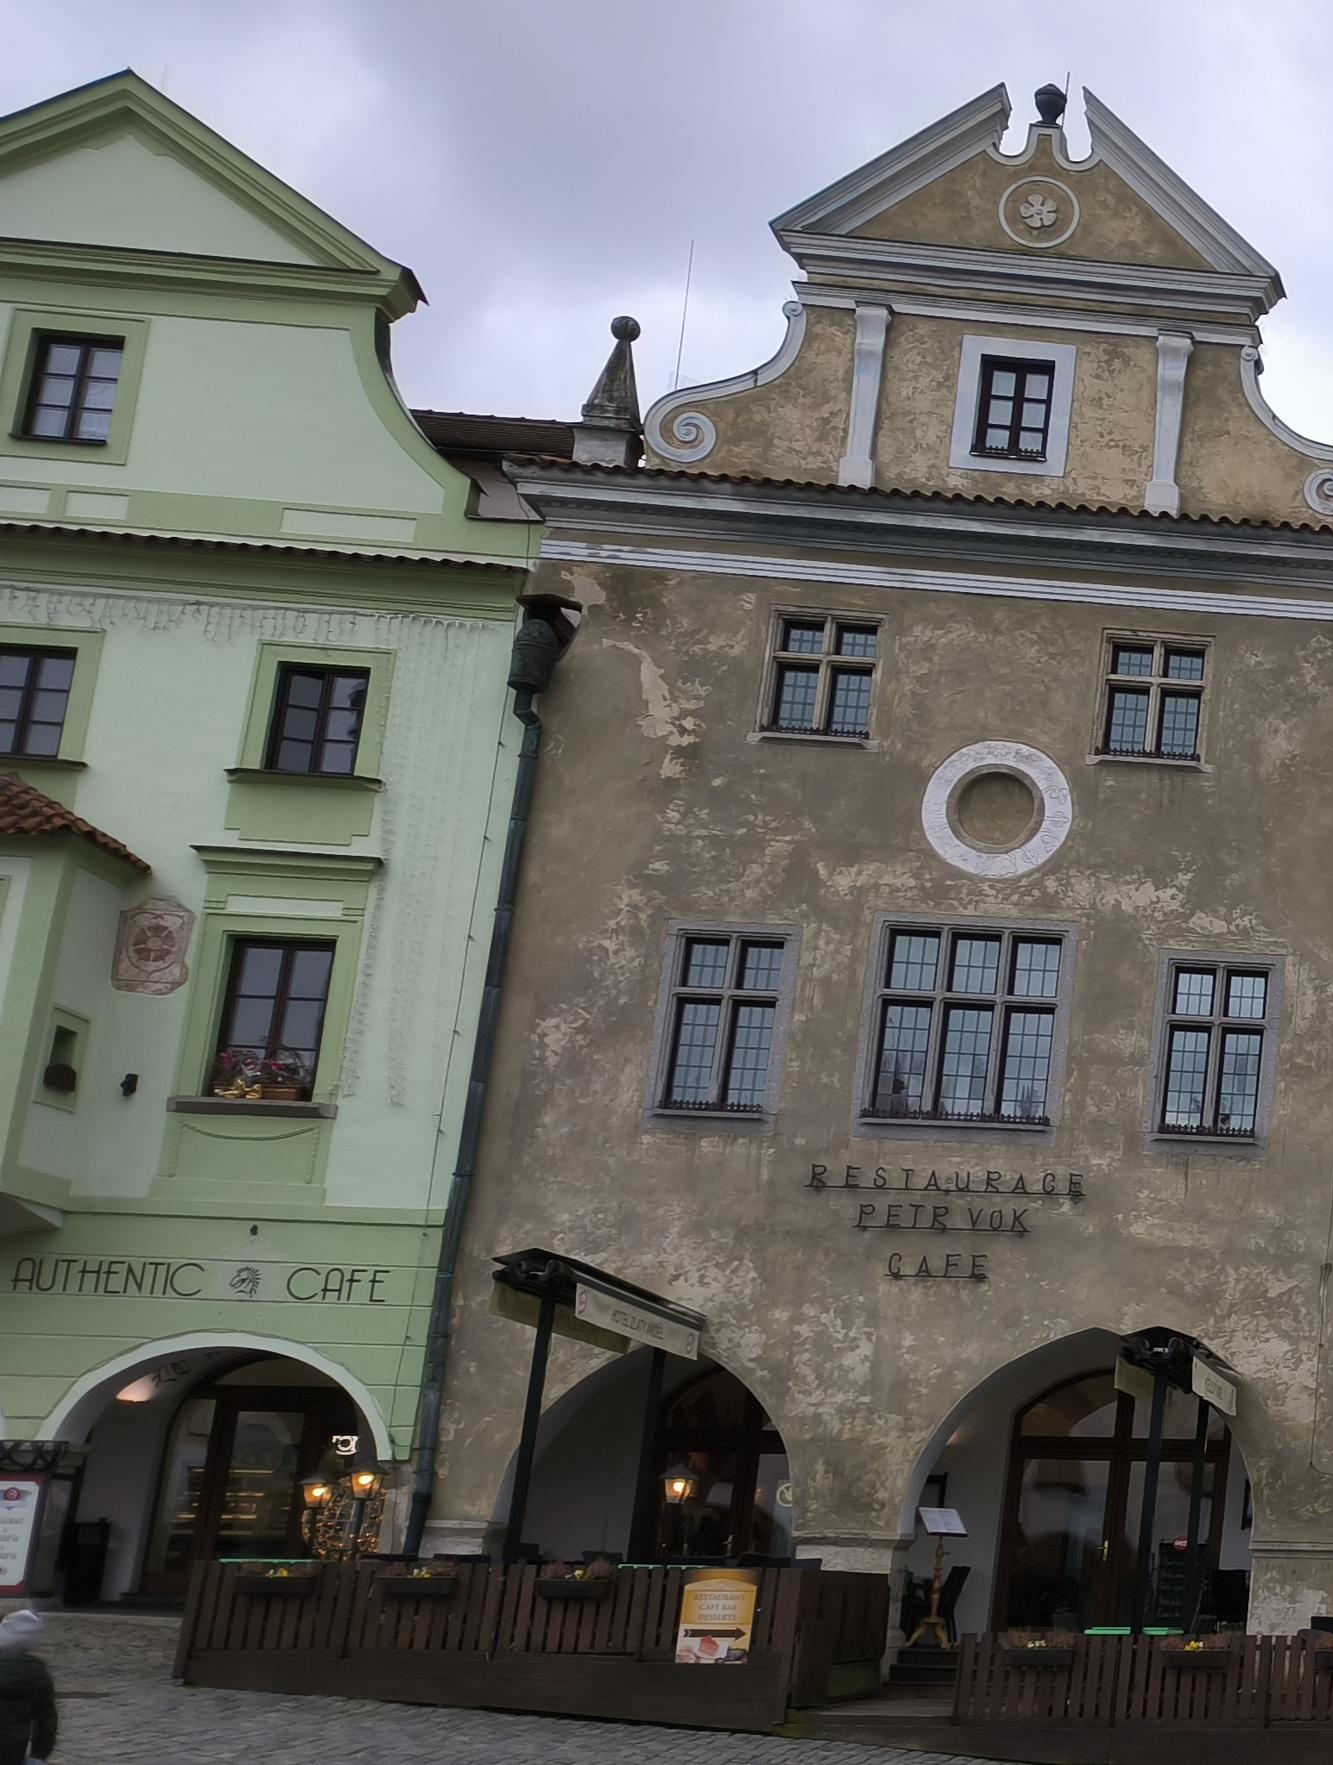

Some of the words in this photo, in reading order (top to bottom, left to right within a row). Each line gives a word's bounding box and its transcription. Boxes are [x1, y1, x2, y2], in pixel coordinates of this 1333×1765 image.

[809, 1163, 1085, 1197] RESTAURACE
[856, 1203, 950, 1230] PETR
[967, 1207, 1030, 1233] VOK
[11, 1257, 206, 1297] AUTHENTIC
[286, 1266, 391, 1303] CAFE
[887, 1252, 989, 1279] CAFE
